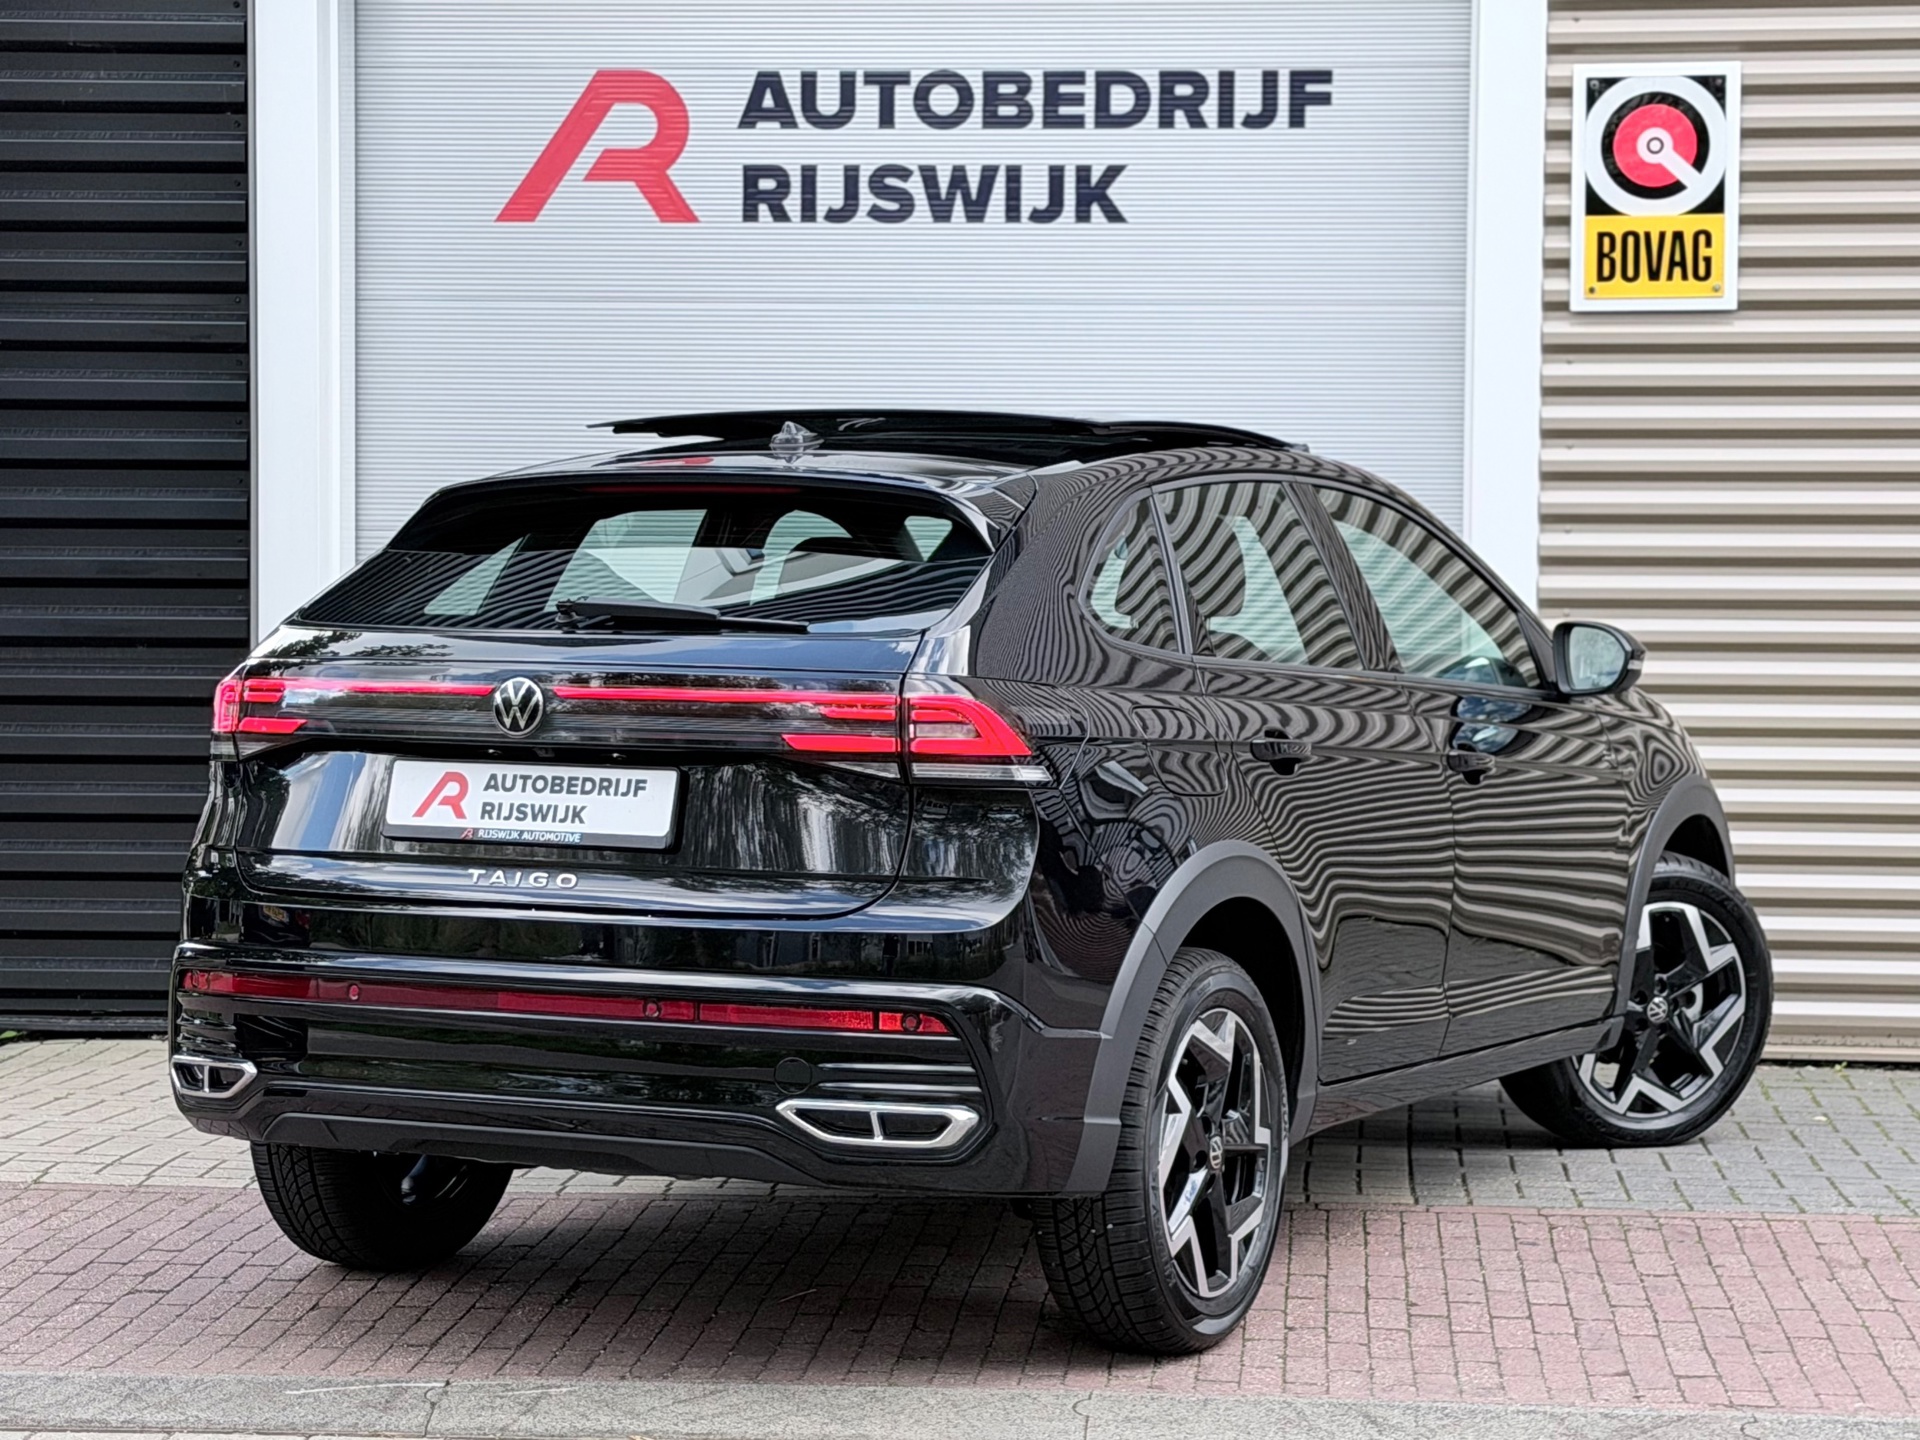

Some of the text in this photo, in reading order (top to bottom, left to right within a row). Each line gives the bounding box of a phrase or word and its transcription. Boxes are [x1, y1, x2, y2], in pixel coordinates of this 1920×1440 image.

[738, 69, 1333, 129] AUTOBEDRIJF
[742, 164, 1128, 223] RIJSWIJK
[1596, 229, 1712, 283] BOVAG
[483, 773, 648, 798] AUTOBEDRIJF
[480, 801, 587, 825] RIJSWIJK
[477, 829, 520, 840] RIJSWIJK
[521, 831, 582, 843] AUTOMOTIVE
[468, 868, 578, 890] TAIGO
